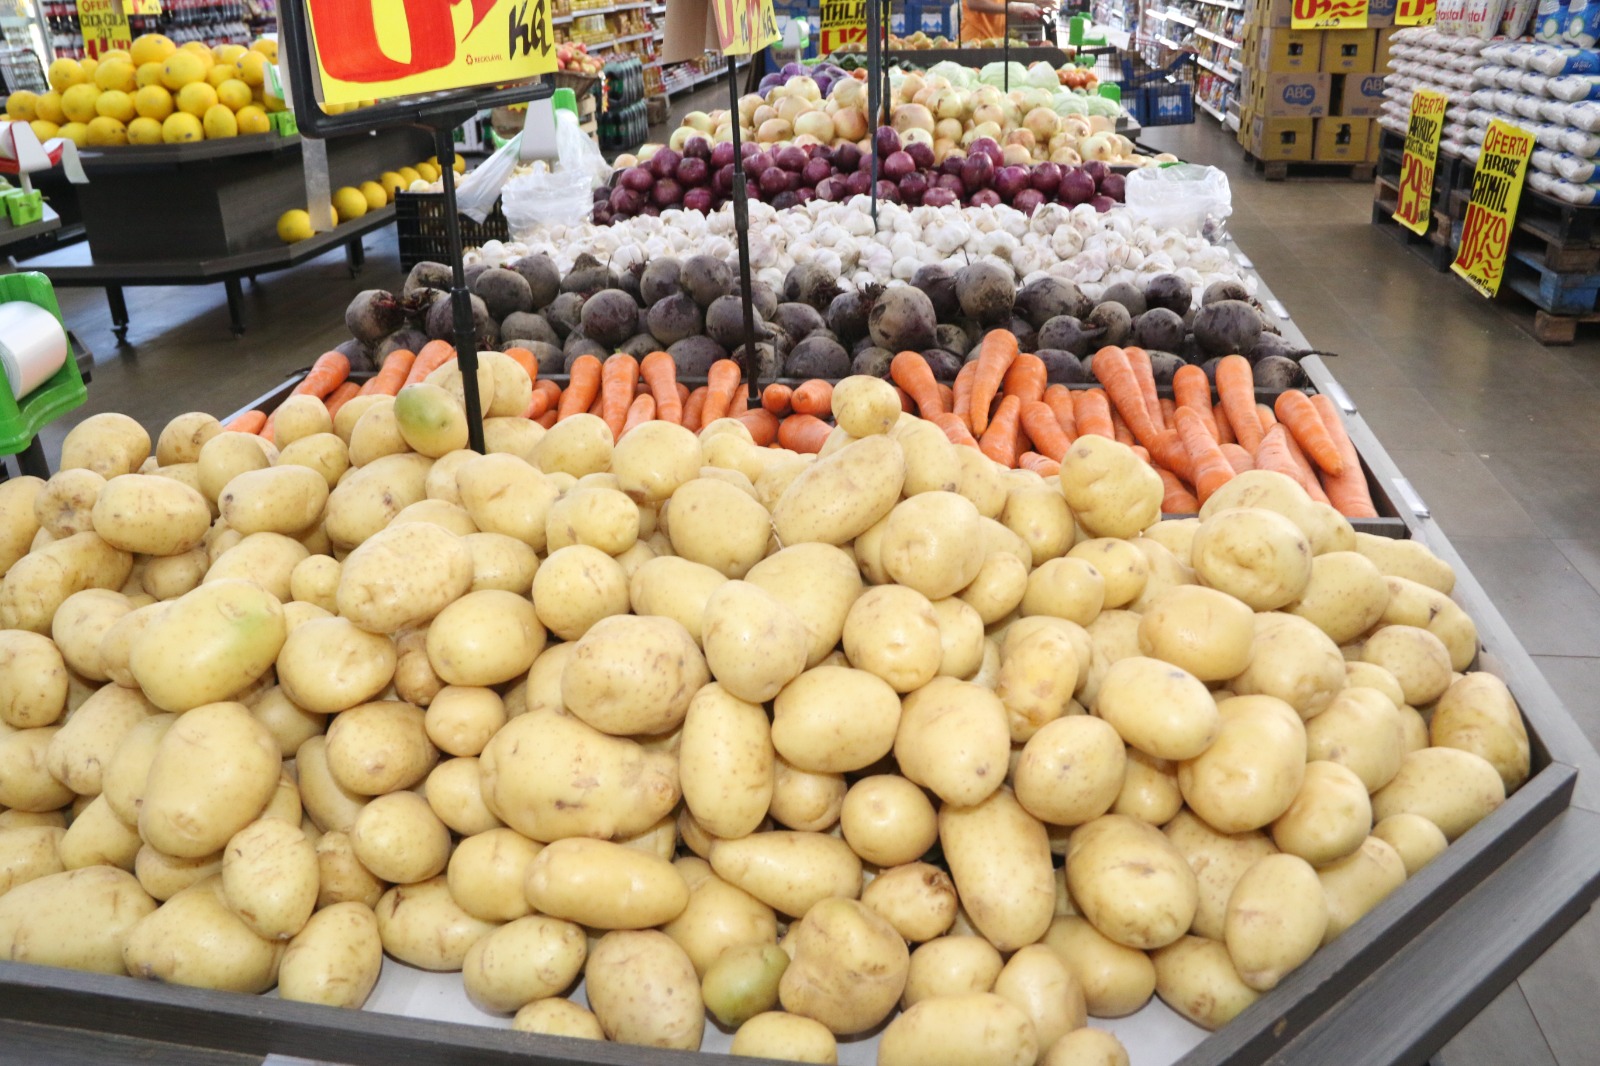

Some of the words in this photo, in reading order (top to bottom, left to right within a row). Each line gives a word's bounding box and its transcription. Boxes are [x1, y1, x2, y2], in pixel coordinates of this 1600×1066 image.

[1285, 86, 1312, 99] ABC
[1411, 93, 1444, 115] OFERTA
[1407, 115, 1437, 145] ARROZ
[1484, 125, 1528, 157] OFERTA
[1482, 153, 1521, 178] ARROZ
[1470, 170, 1512, 214] CAMIL
